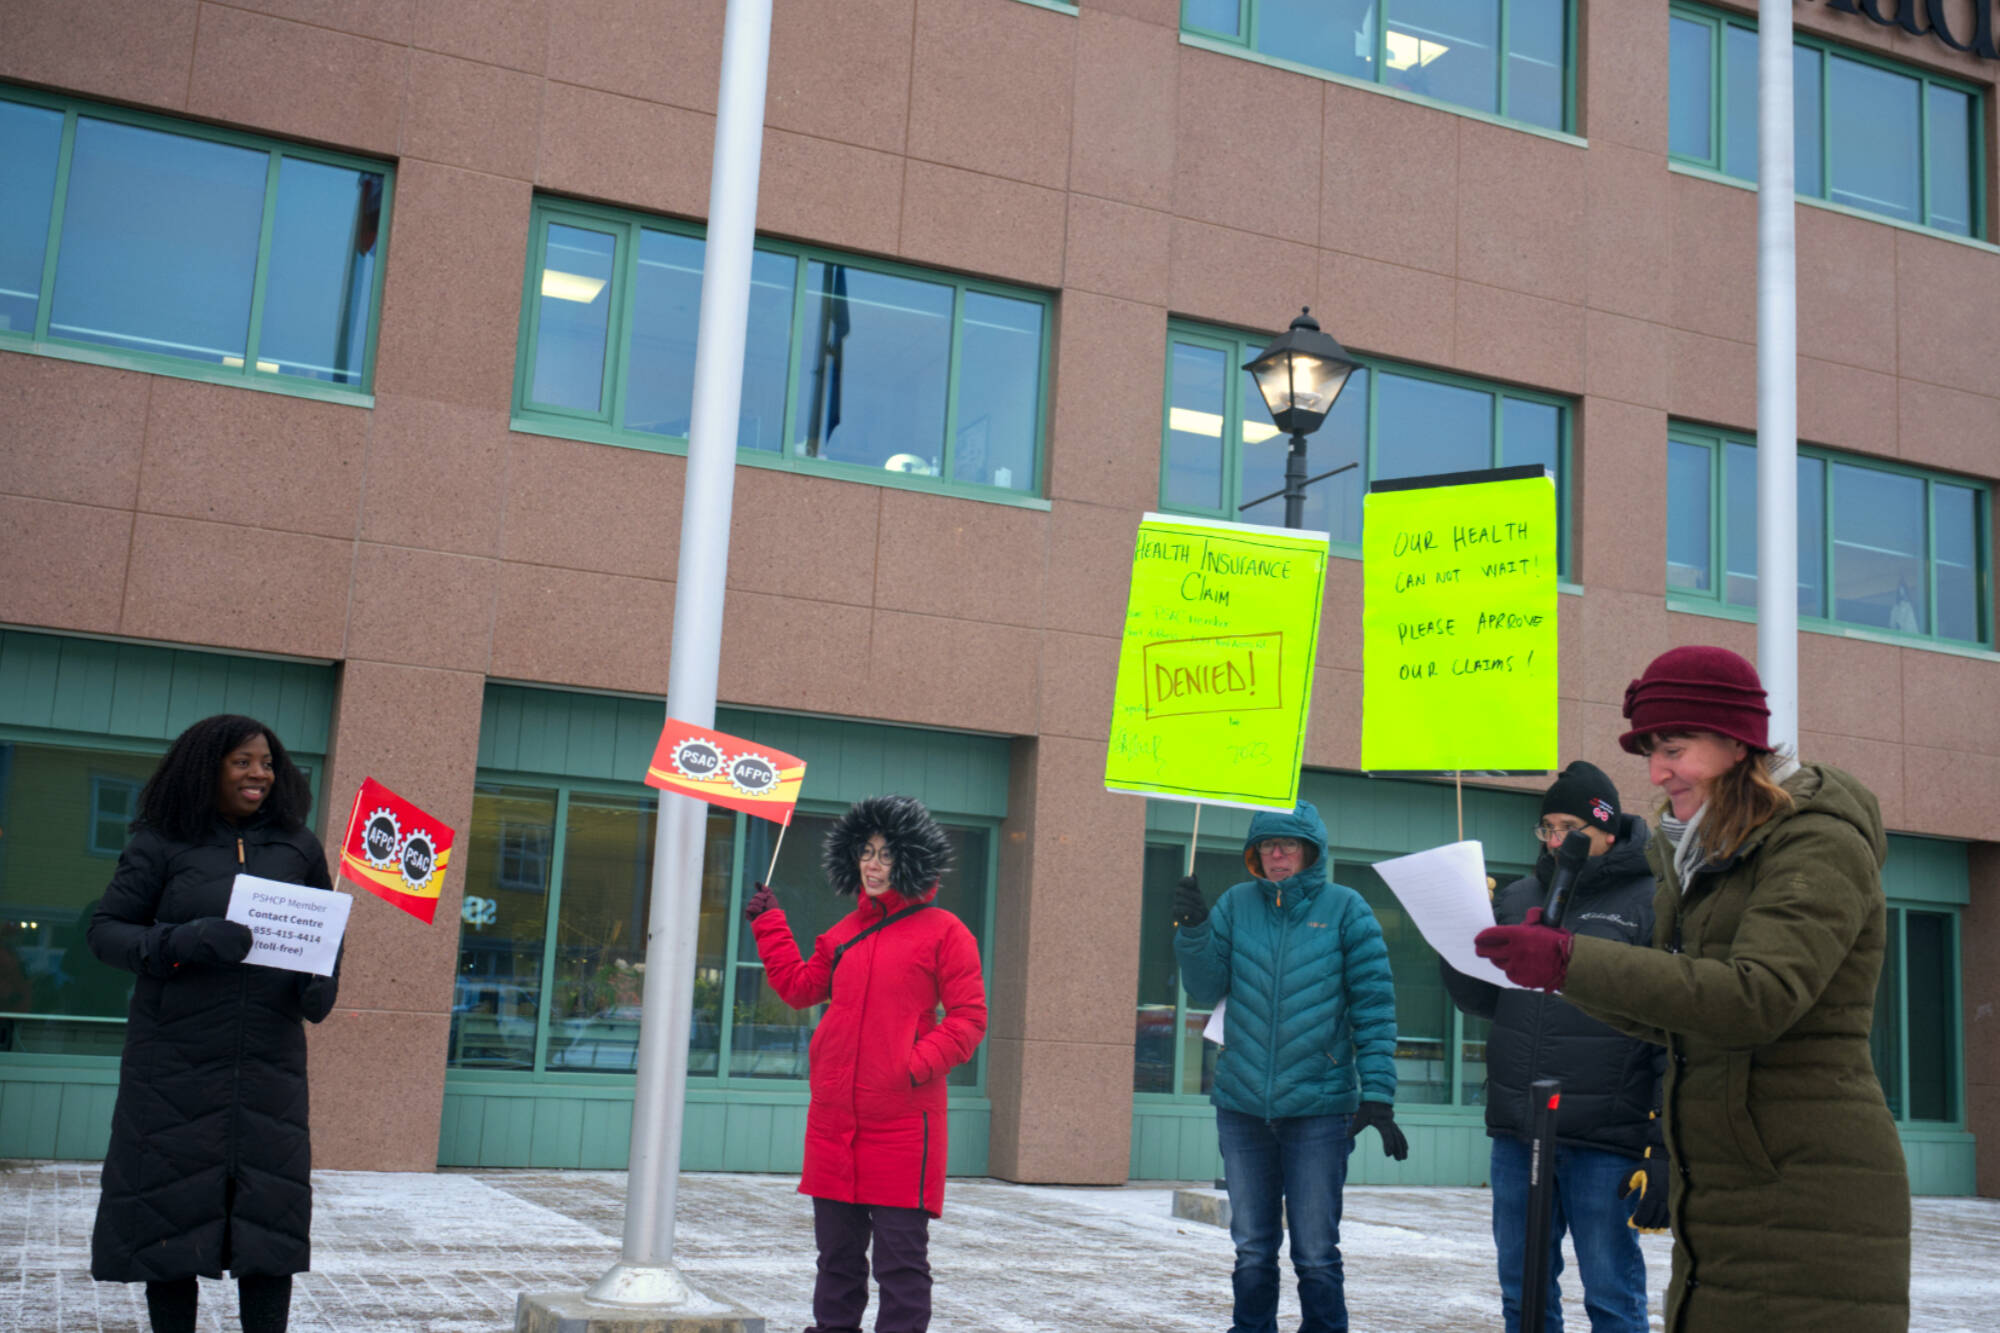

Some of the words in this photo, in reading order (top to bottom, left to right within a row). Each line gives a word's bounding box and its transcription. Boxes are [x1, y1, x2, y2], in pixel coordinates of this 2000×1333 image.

[1134, 533, 1190, 563] HEALTH
[1393, 531, 1438, 558] OUR
[1453, 522, 1528, 553] HEALTH
[1395, 572, 1426, 594] CAN
[1435, 569, 1461, 584] NOT
[1481, 555, 1541, 579] WAIT!
[1397, 618, 1456, 645] PLEASE
[1155, 651, 1256, 702] DENIED!
[1399, 662, 1439, 681] OUR
[682, 750, 717, 769] PSAC
[735, 764, 772, 784] AFPC
[368, 826, 395, 852] AFPC
[405, 847, 431, 872] PSAC
[252, 892, 286, 905] PSHCP
[288, 899, 328, 913] Member
[248, 908, 288, 923] Contact
[290, 916, 324, 929] Centre
[254, 940, 304, 957] (toll-free)
